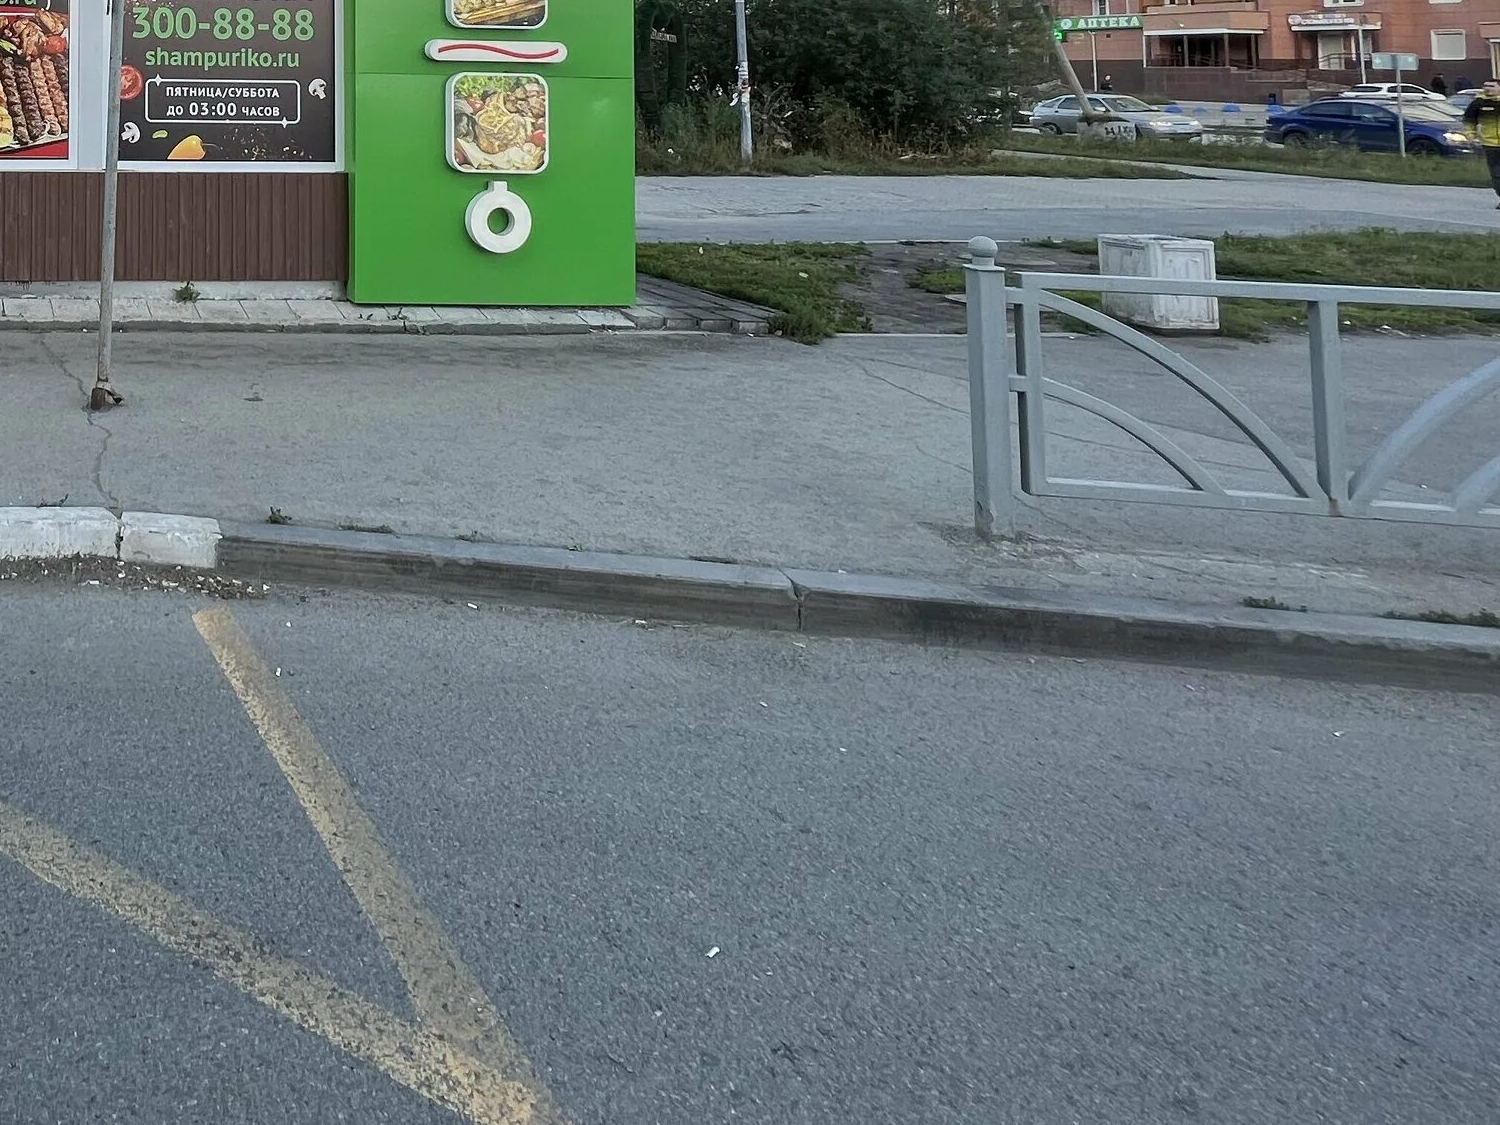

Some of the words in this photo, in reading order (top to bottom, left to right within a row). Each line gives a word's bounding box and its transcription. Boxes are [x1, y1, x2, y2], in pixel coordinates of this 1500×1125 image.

[131, 5, 315, 42] 300-88-88
[1077, 16, 1140, 29] АПТЕКА
[145, 46, 300, 71] shampuriko.ru
[166, 86, 280, 100] ПЯТНИЦА/СУББОТА
[189, 102, 237, 117] 03:00
[241, 106, 280, 117] ЧАСОВ
